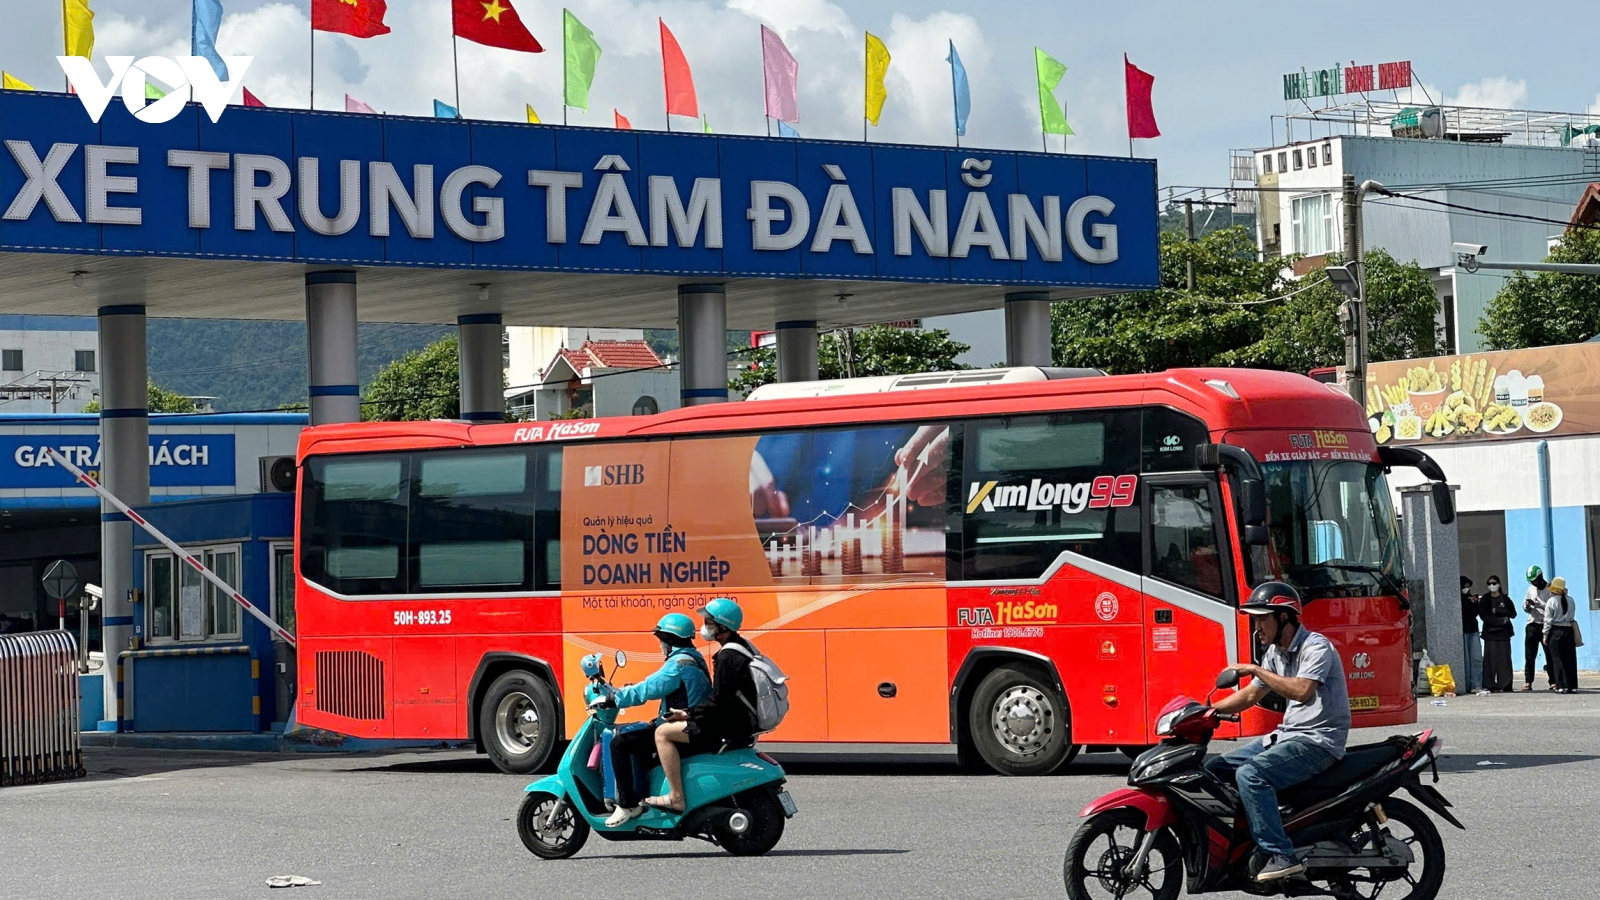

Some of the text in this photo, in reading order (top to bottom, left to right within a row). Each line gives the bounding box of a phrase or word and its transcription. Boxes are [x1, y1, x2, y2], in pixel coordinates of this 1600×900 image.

[1378, 61, 1412, 89] MINH
[2, 139, 1119, 264] XE TRUNG TÂM ĐÀ NẴNG
[514, 427, 544, 442] FUTA
[1290, 434, 1314, 448] FUTA
[14, 445, 55, 467] GA
[1281, 452, 1291, 461] XE
[604, 463, 645, 486] SHB
[583, 514, 653, 527] Quản lý hiệu quả
[583, 524, 686, 556] DÒNG TIỀN
[583, 555, 731, 588] DOANH NGHIỆP
[583, 596, 602, 611] Một
[605, 595, 619, 609] tài
[621, 593, 656, 609] khoản,
[658, 594, 686, 610] ngàn
[689, 591, 707, 609] giải
[393, 610, 452, 626] 50H-893.25
[958, 607, 996, 627] FUTA
[971, 628, 1003, 639] Hotline:
[1361, 671, 1375, 679] LONG
